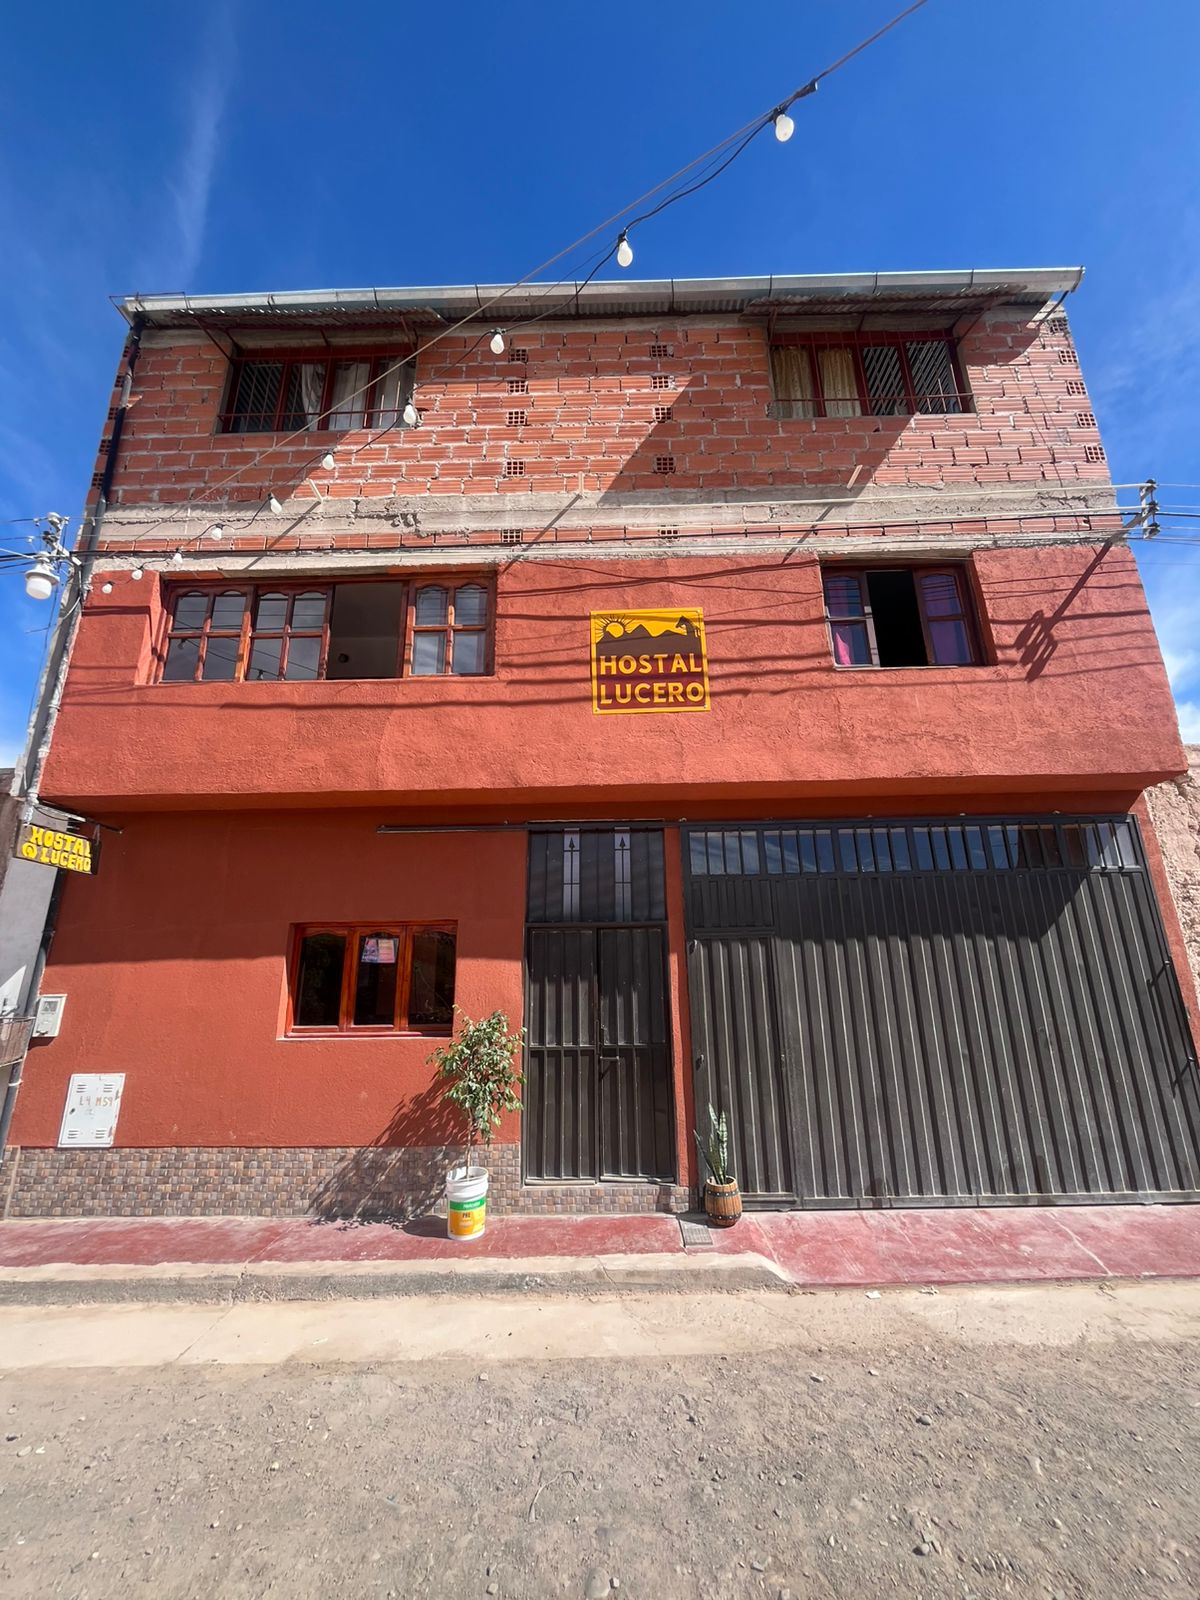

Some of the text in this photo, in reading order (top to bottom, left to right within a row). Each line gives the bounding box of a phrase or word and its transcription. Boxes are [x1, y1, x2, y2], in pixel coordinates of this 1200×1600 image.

[600, 653, 702, 675] HOSTAL
[600, 682, 705, 704] LUCERO
[40, 847, 92, 872] LUCERO
